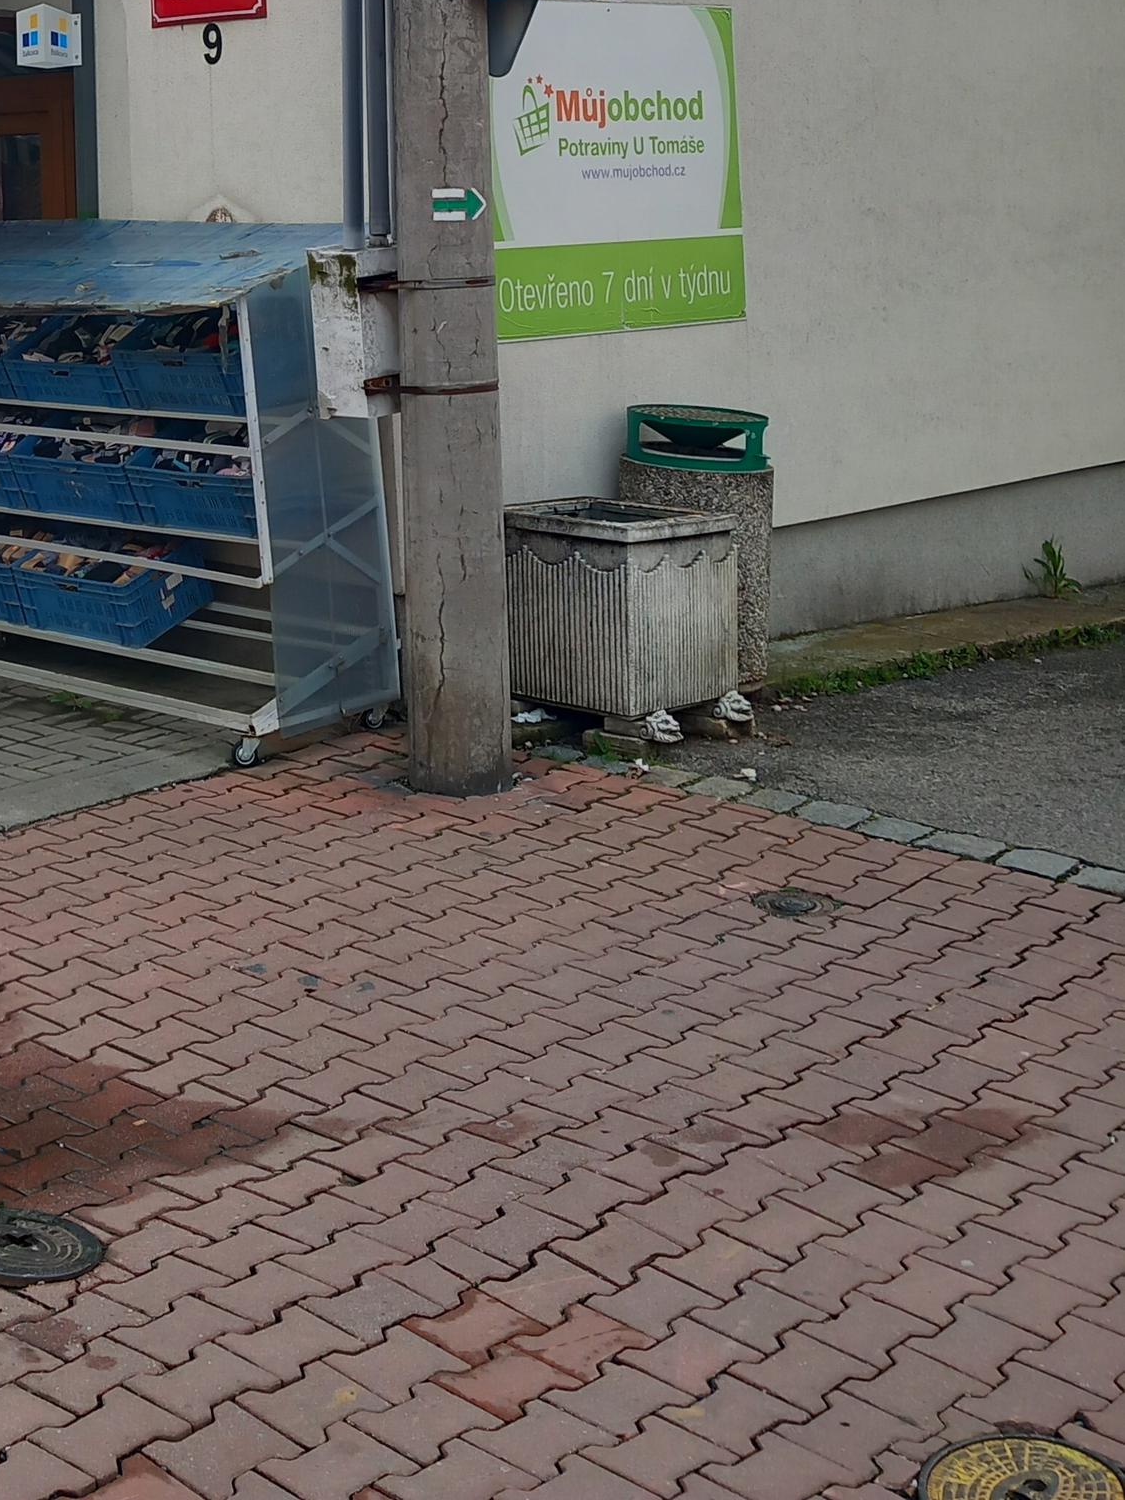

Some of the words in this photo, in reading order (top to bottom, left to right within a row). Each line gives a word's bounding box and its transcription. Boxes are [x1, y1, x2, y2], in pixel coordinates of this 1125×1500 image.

[202, 23, 223, 65] 9
[556, 88, 703, 128] Můjobchod
[558, 138, 628, 159] Potraviny
[634, 137, 644, 155] U
[649, 135, 705, 154] Tomáše
[581, 165, 686, 181] www.mujobchod.cz
[499, 274, 593, 313] Otevřeno
[602, 272, 614, 304] 7
[624, 267, 654, 303] dní
[661, 276, 671, 299] v
[679, 264, 731, 304] týdnu
